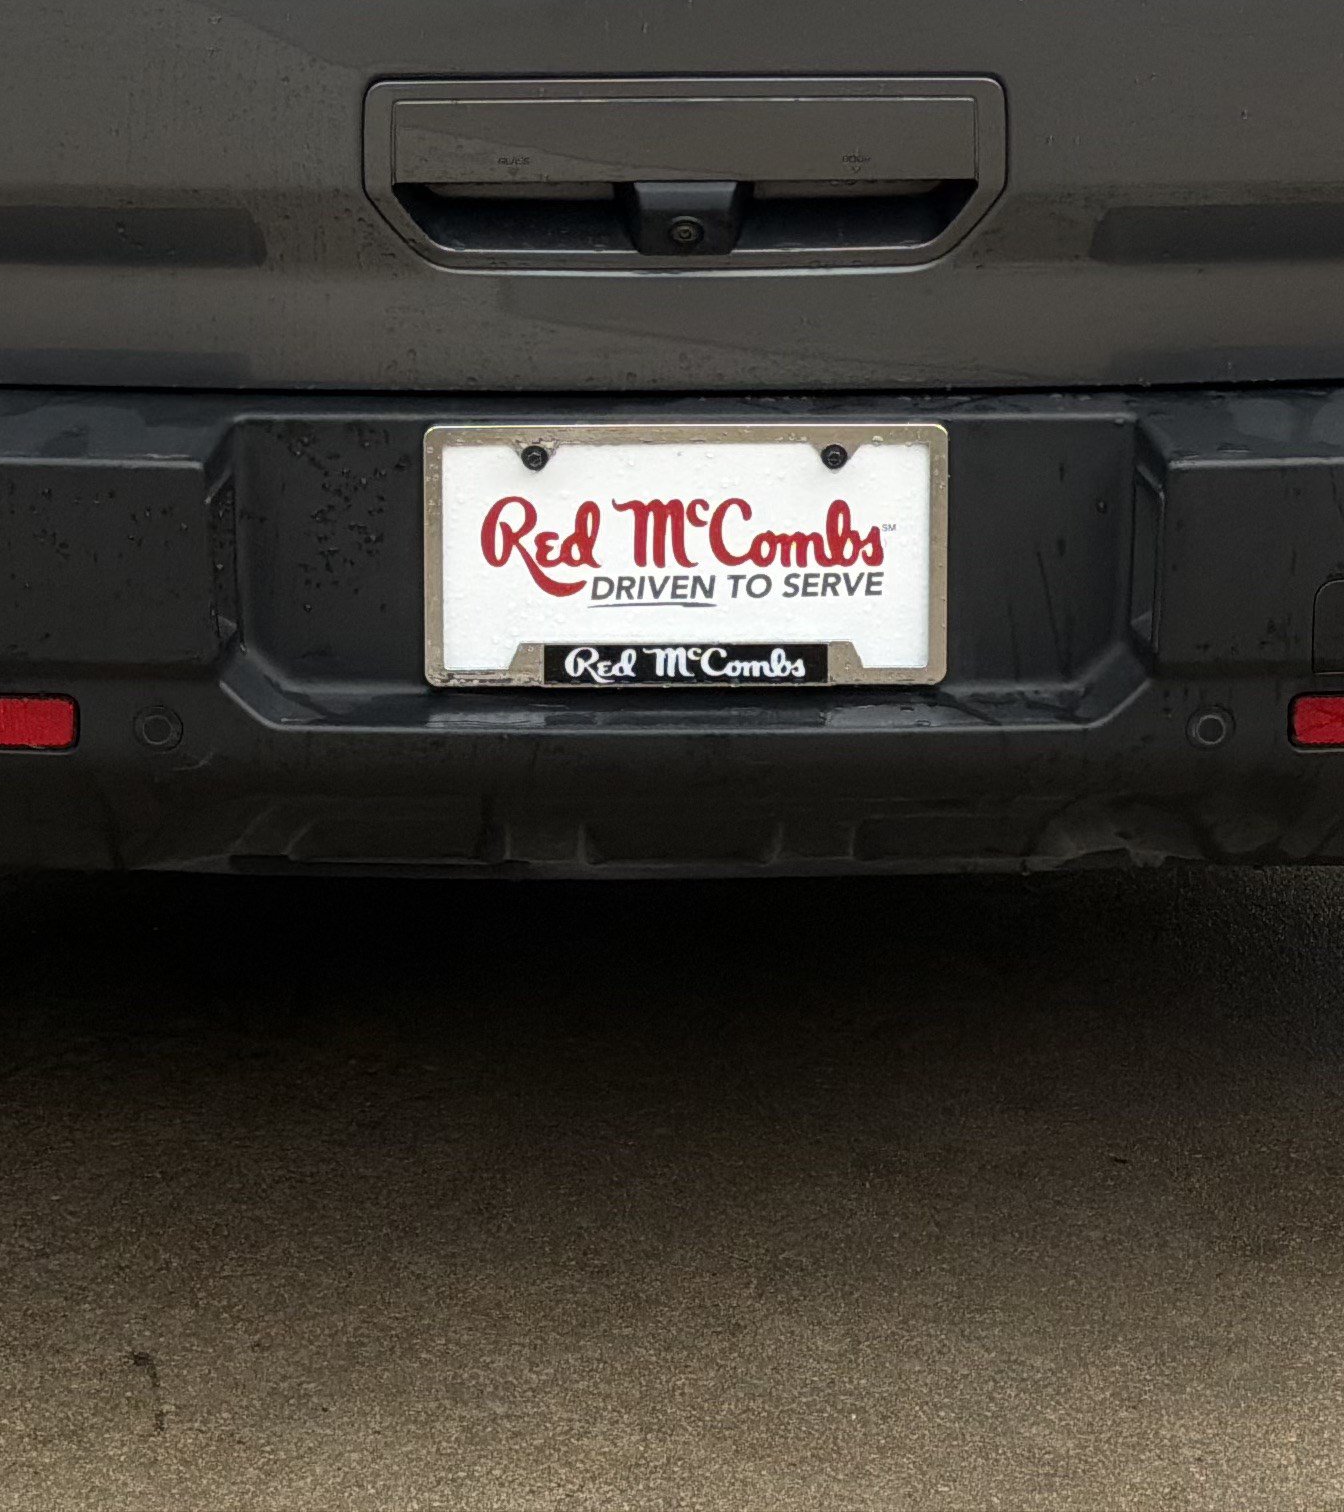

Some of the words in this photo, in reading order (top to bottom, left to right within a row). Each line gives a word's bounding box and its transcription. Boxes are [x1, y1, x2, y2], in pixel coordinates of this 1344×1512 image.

[480, 495, 602, 598] Red
[612, 497, 884, 569] McCombs
[590, 574, 717, 601] DRIVEN
[726, 573, 773, 599] TO
[781, 571, 885, 598] SERVE
[564, 646, 637, 684] Red
[642, 647, 806, 678] McCombs
